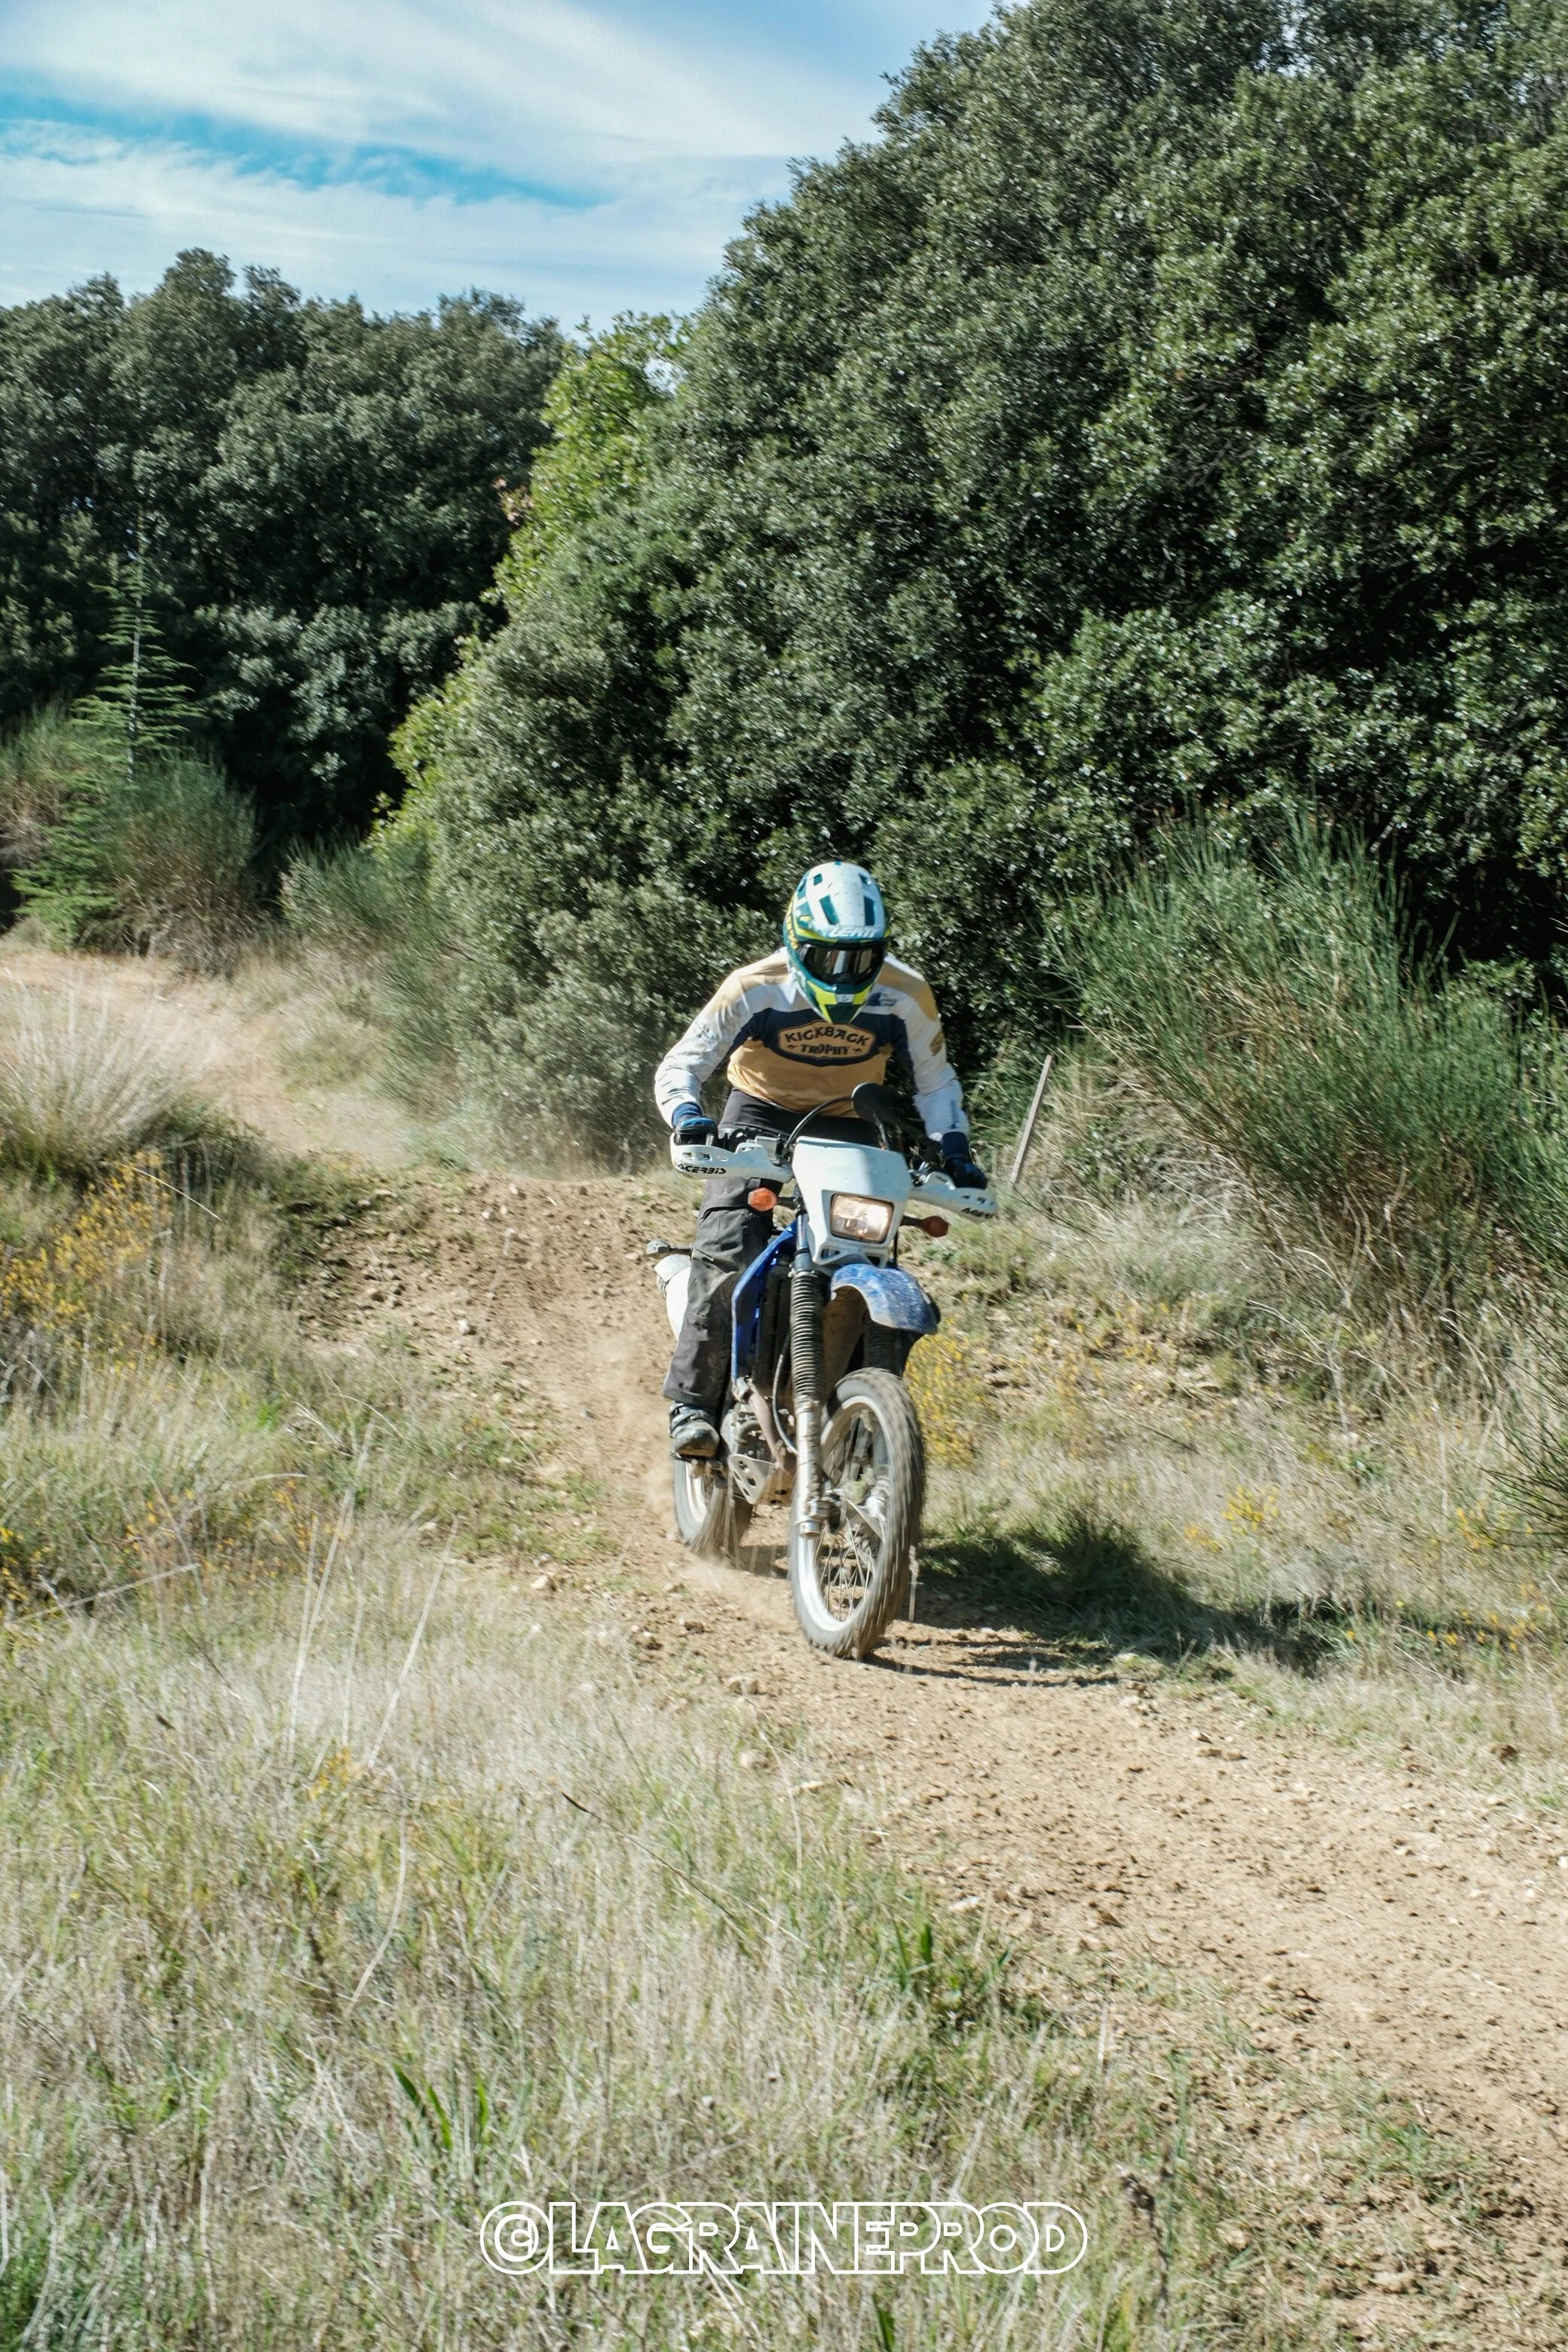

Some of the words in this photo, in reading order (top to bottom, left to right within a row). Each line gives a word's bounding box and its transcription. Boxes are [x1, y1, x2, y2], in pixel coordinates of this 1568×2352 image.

[785, 1026, 868, 1046] KICKBACK
[801, 1043, 851, 1055] TROPHY
[677, 1163, 727, 1174] ACERBIS
